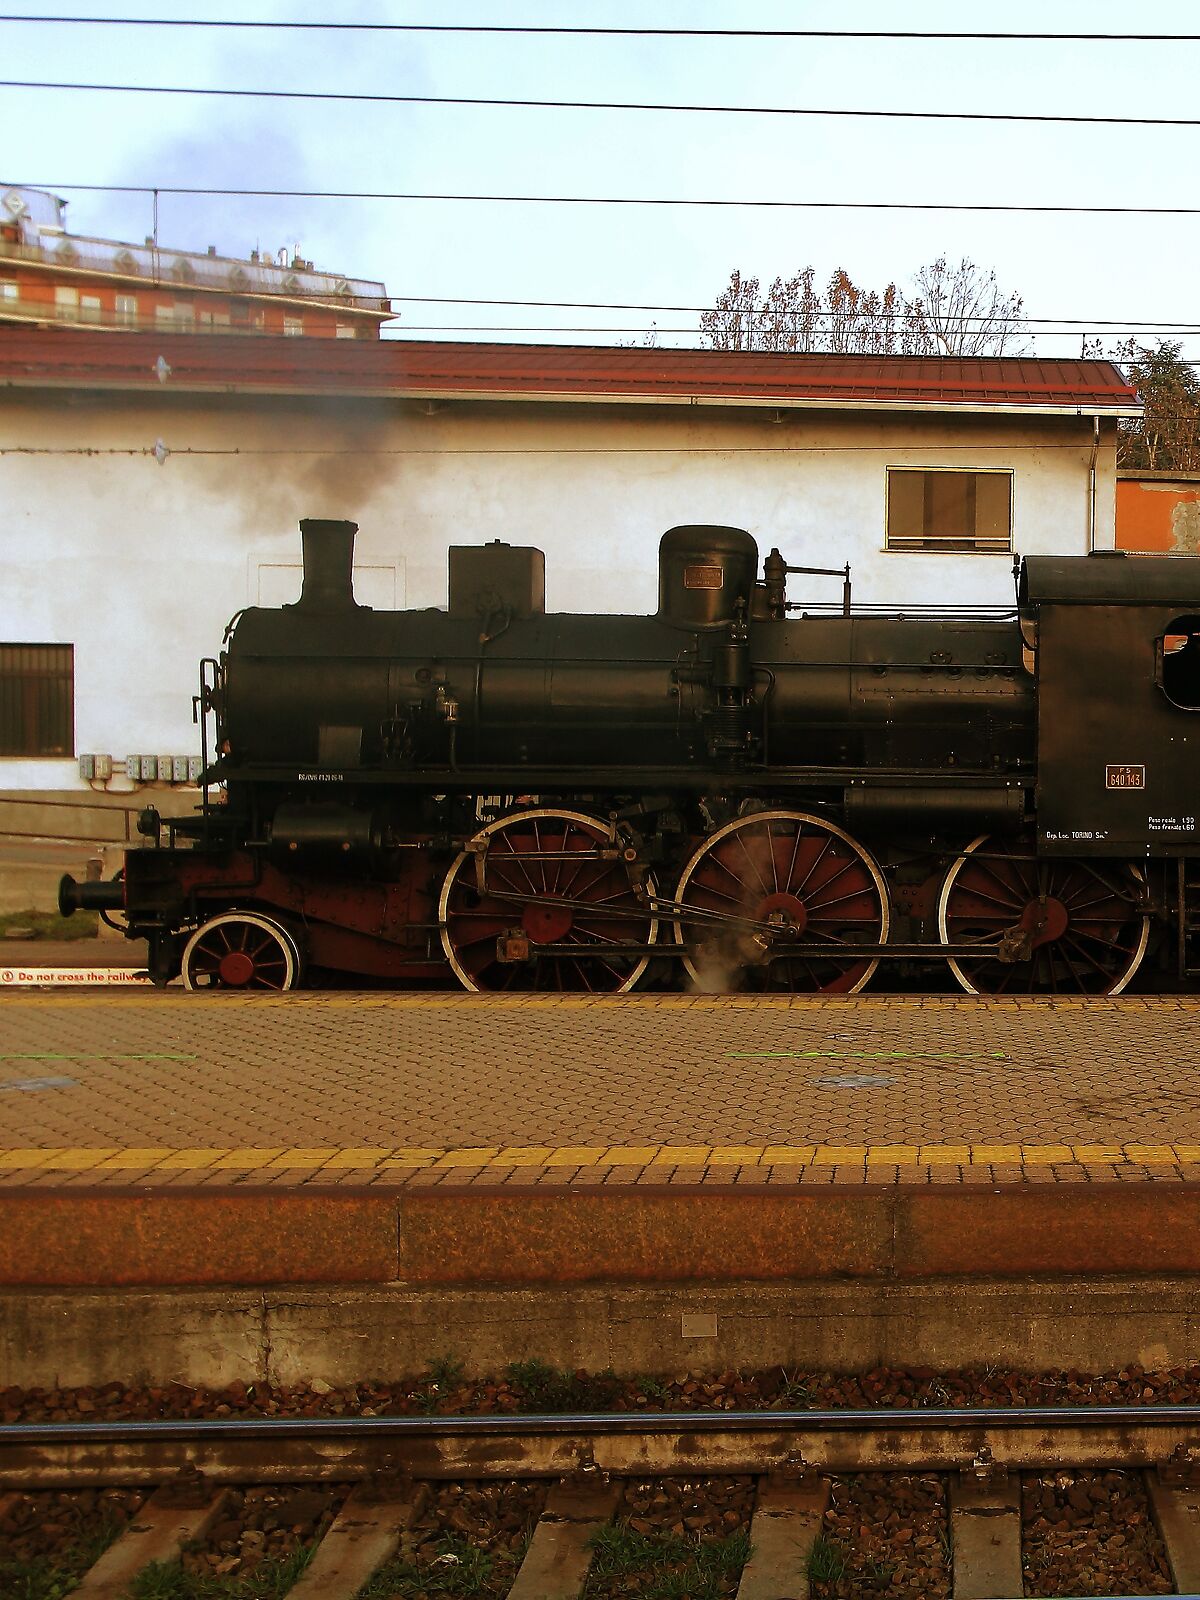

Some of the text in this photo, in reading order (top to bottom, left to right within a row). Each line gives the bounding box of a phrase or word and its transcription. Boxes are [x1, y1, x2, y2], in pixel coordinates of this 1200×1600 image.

[1071, 831, 1093, 839] TORINO
[18, 972, 33, 981] Do
[36, 973, 54, 981] not
[87, 972, 105, 981] the
